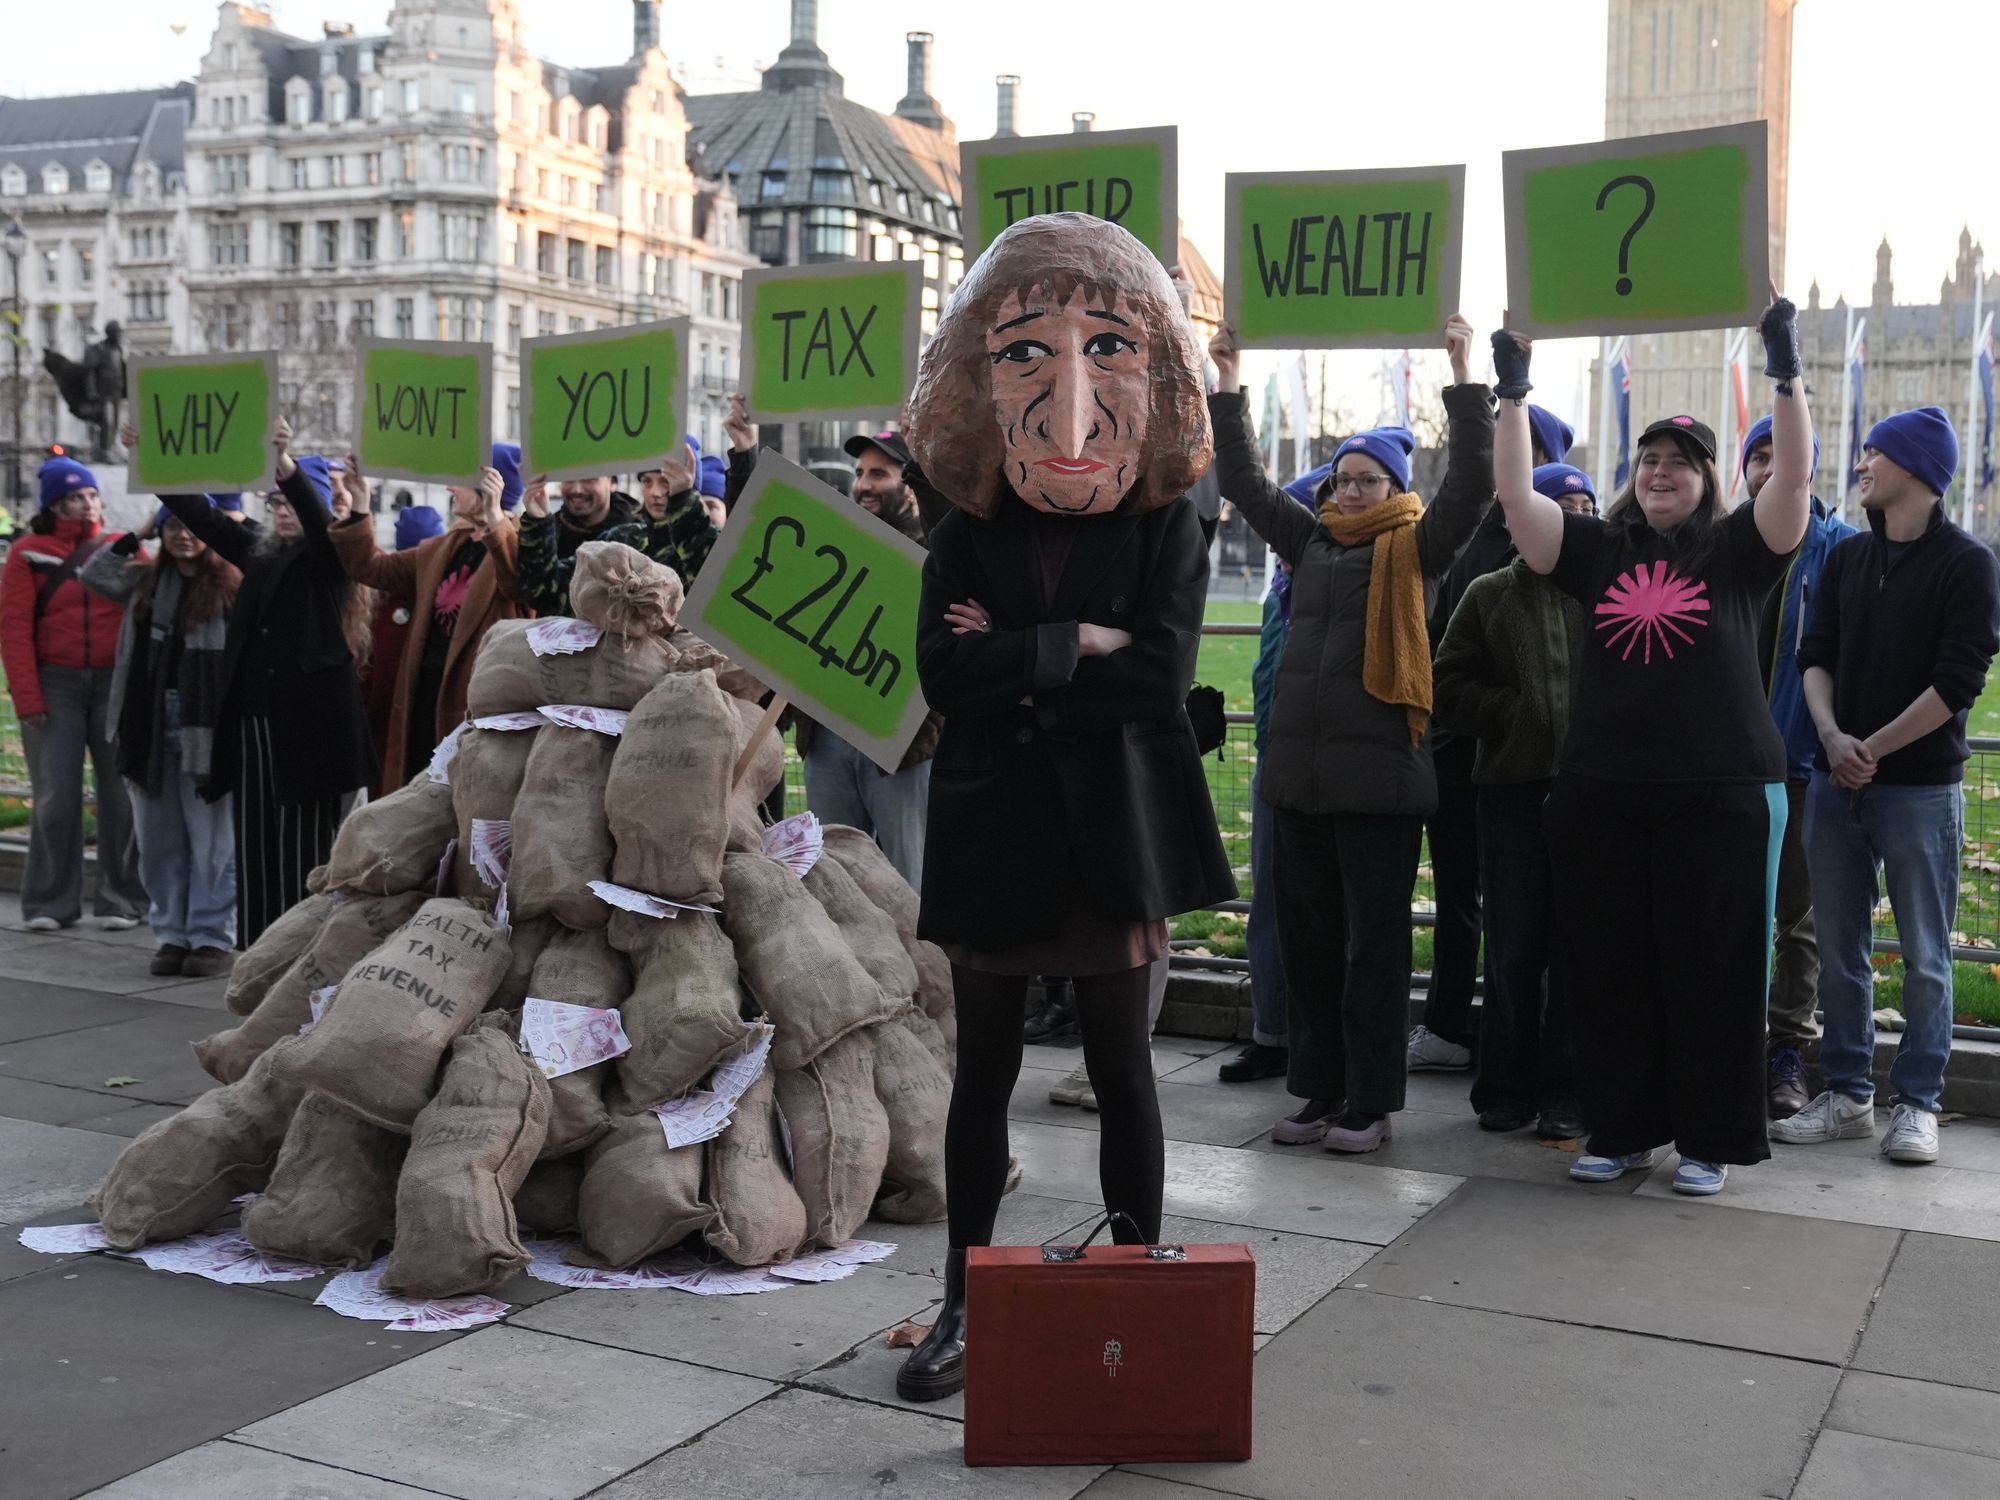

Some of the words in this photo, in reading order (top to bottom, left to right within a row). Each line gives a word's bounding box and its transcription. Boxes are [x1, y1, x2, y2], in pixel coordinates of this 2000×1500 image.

[1252, 211, 1432, 298] WEALTH
[1595, 175, 1656, 297] ?
[772, 304, 878, 382] TAX
[153, 390, 240, 456] WHY
[375, 382, 466, 440] WON'T
[556, 365, 651, 442] YOU
[730, 515, 902, 698] £24bn
[407, 938, 455, 973] TAX
[1103, 1351, 1124, 1366] ER
